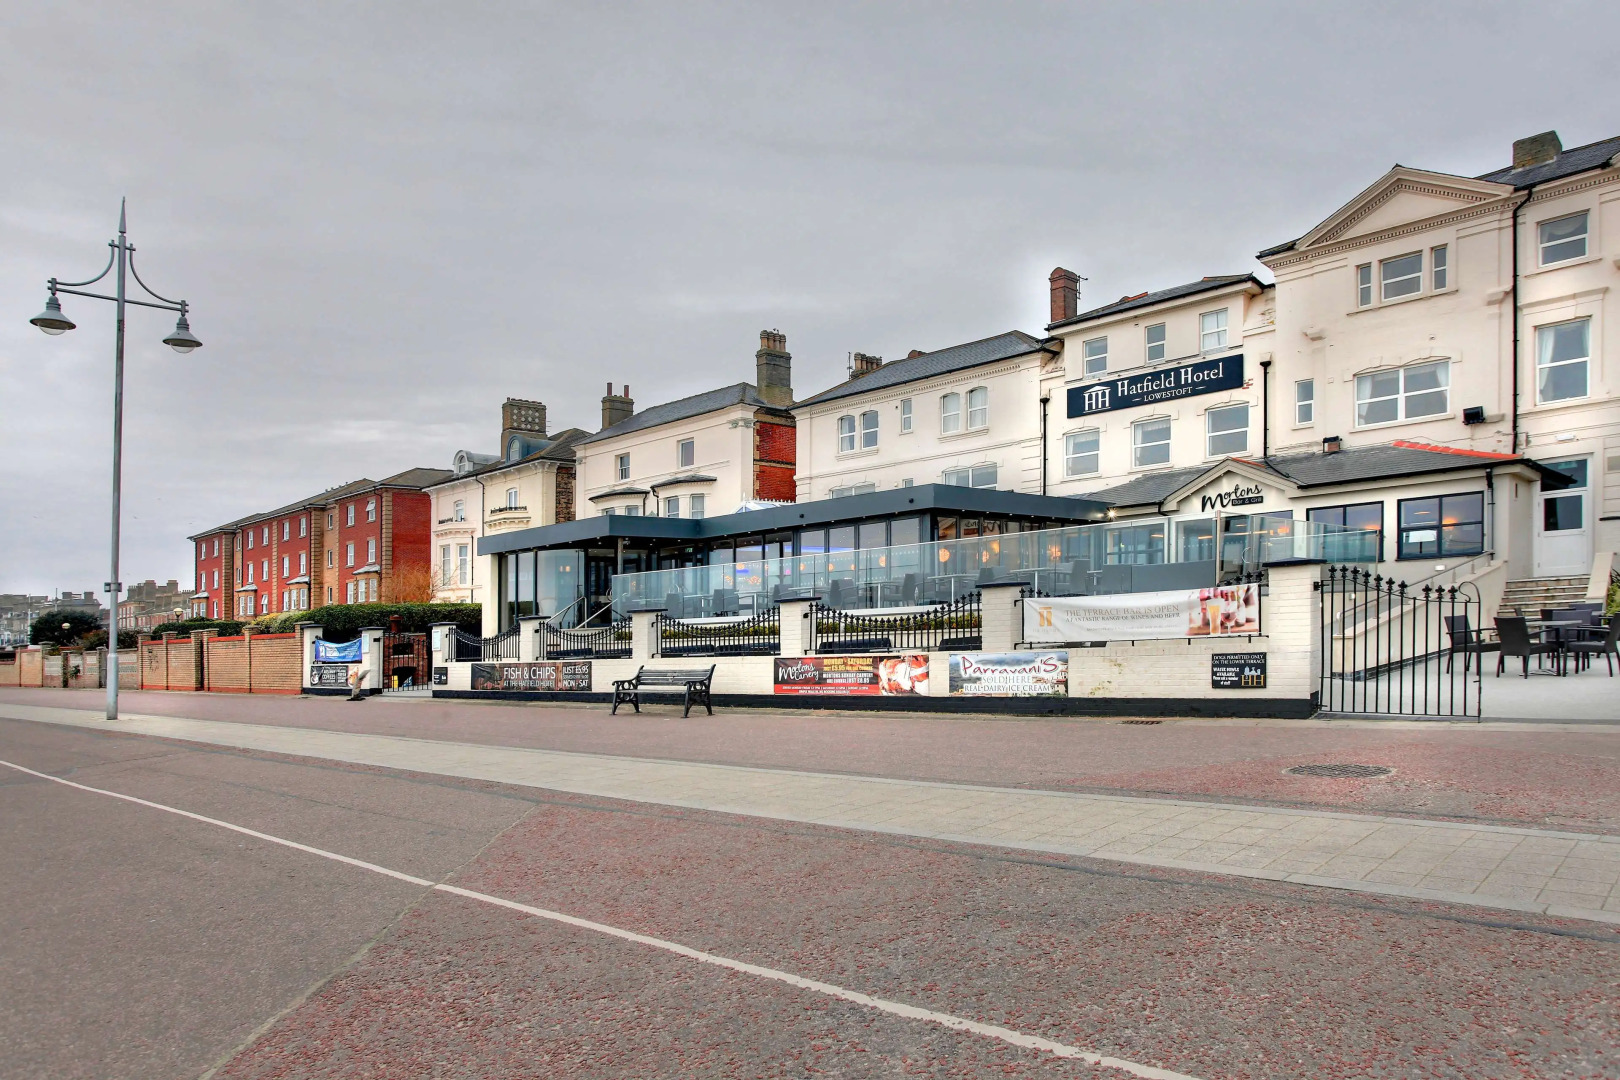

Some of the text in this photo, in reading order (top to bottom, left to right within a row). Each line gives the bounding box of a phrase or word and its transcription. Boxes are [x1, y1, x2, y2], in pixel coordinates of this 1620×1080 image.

[1117, 362, 1224, 397] Hatfield Hotel
[1144, 386, 1192, 402] LOWESTOFT
[1202, 484, 1262, 512] Mortons
[1154, 605, 1179, 613] OPEN
[504, 667, 521, 679] FISH
[524, 667, 529, 679] &
[531, 667, 556, 679] CHIPS
[563, 666, 574, 675] JUST
[779, 660, 815, 682] Mortons
[795, 670, 818, 681] Carvery
[982, 676, 1006, 684] SOLD
